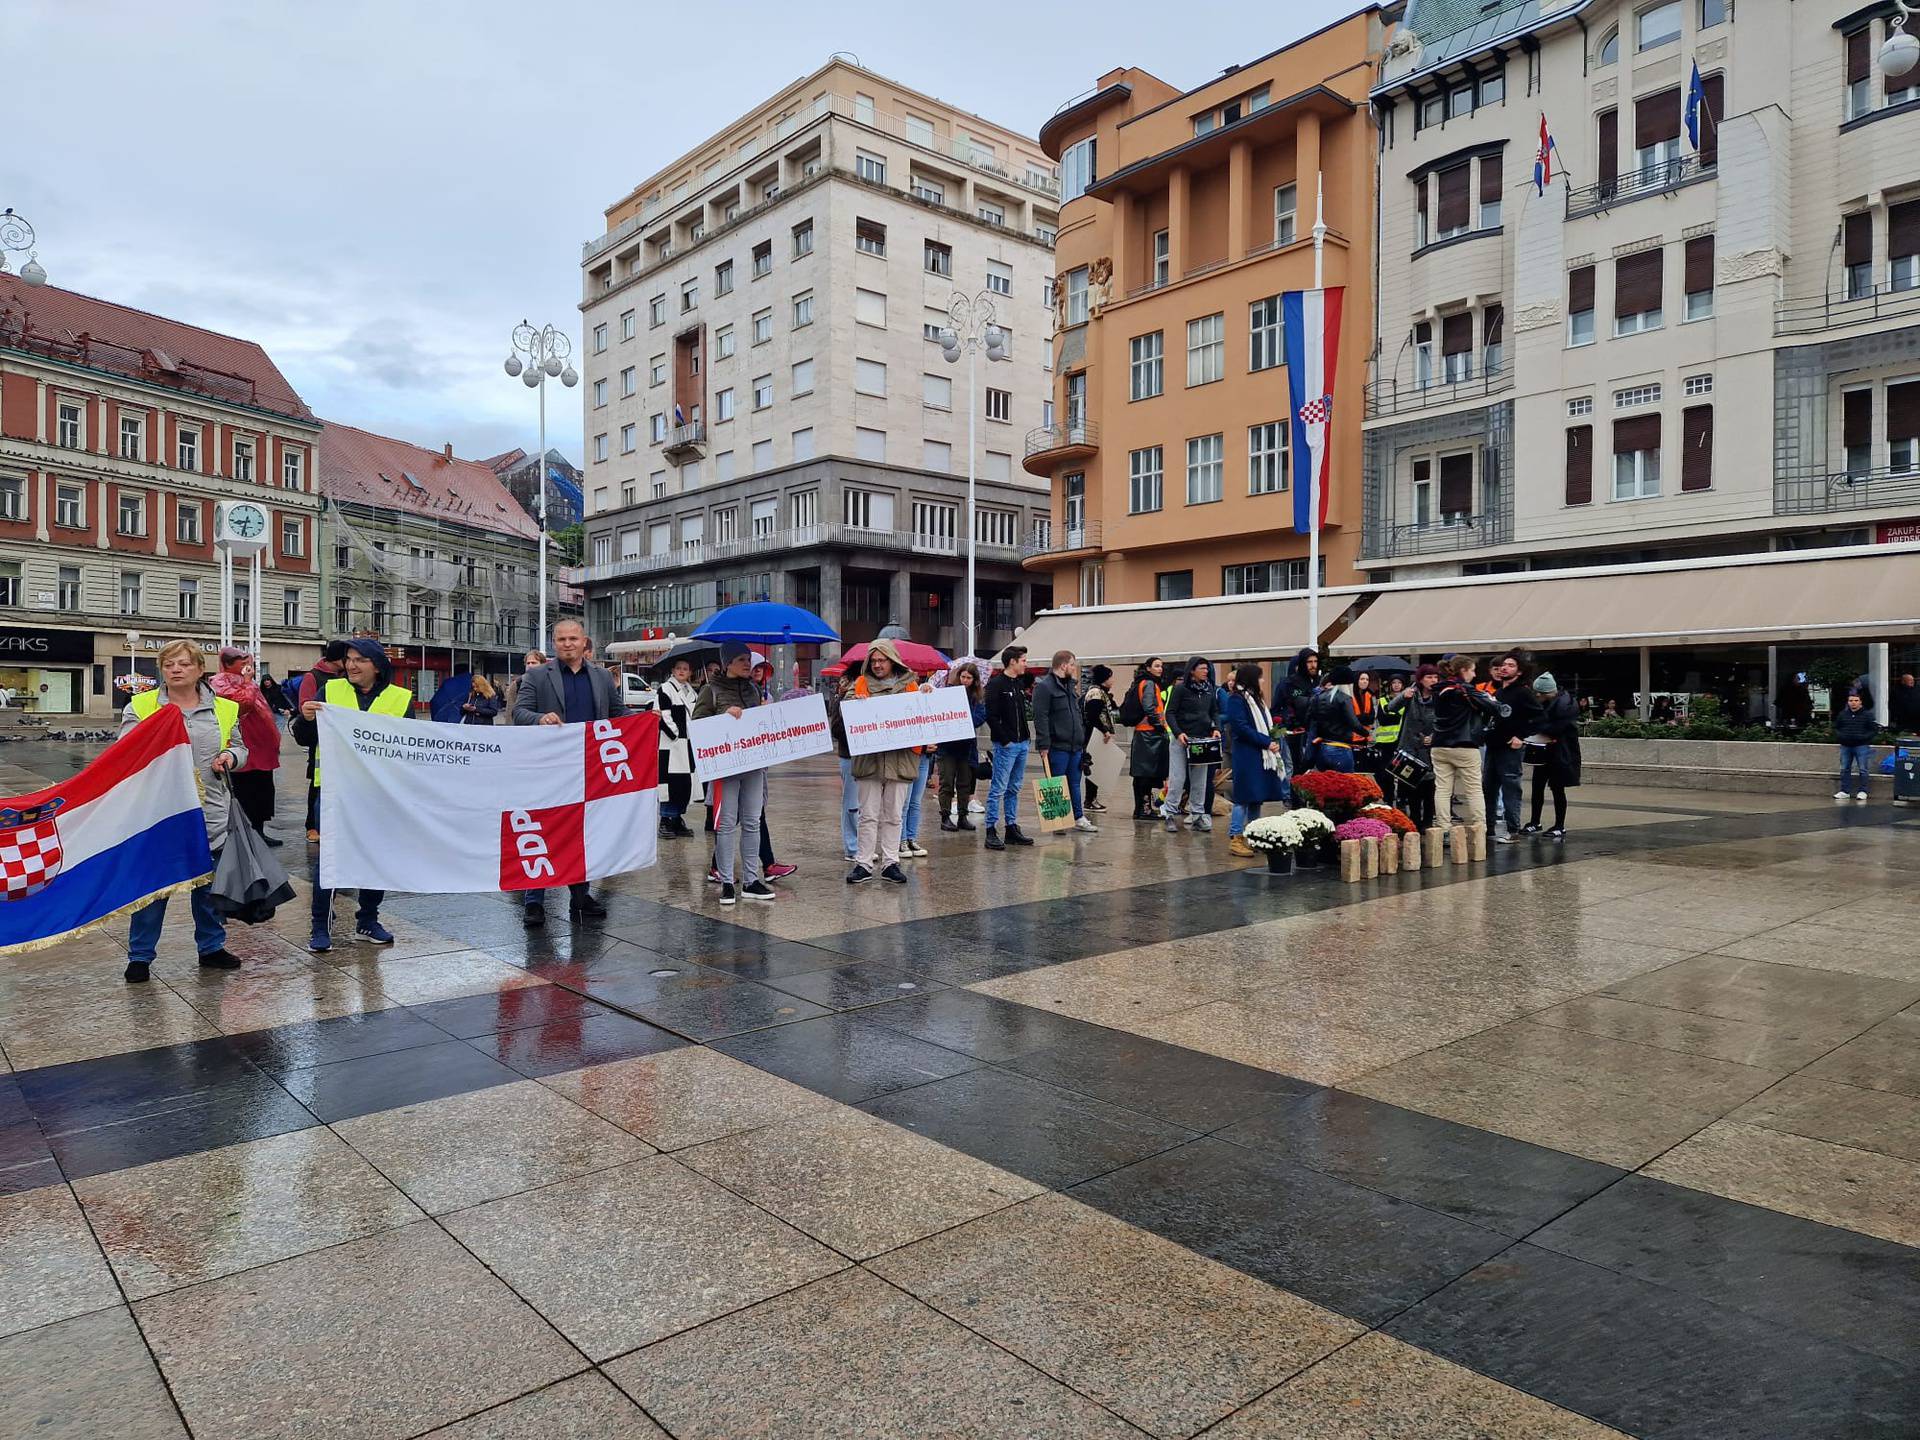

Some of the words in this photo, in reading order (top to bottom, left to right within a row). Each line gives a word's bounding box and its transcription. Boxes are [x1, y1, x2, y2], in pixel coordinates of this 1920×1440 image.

[1887, 526, 1914, 536] ZAKUP
[353, 728, 502, 753] SOCIJALDEMOKRATSKA
[697, 742, 731, 759] Zagreb
[734, 721, 826, 750] #SafePlace4Women
[850, 722, 878, 734] Zagreb
[354, 742, 403, 759] PARTIJA
[406, 750, 471, 766] HRVATSKE
[593, 719, 633, 783] SDP
[510, 809, 554, 879] SDP
